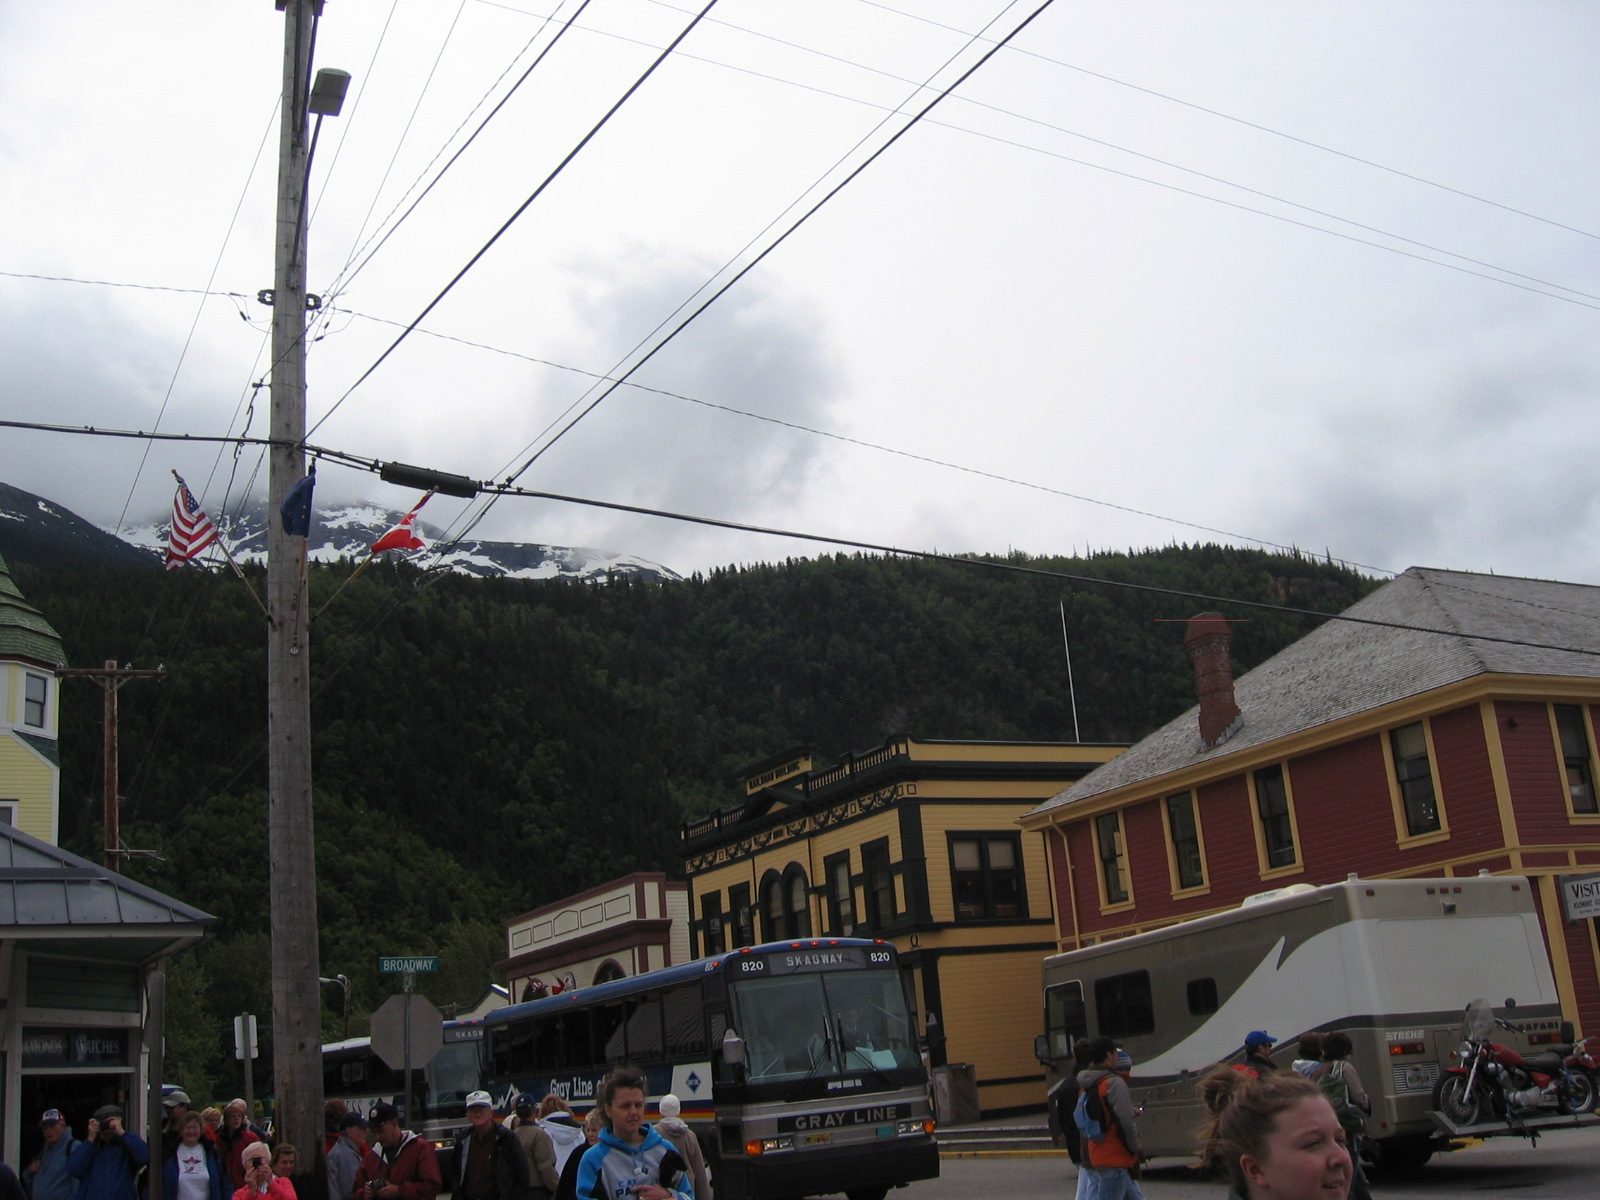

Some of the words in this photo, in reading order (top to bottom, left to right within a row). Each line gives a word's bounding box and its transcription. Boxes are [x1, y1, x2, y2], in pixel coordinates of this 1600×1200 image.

[786, 953, 844, 967] SKAGWAY
[870, 952, 890, 962] 820
[383, 959, 433, 971] BROADWAY
[741, 961, 764, 972] 820
[1518, 1021, 1559, 1031] SAFARI
[75, 1040, 120, 1054] WATCHES
[550, 1078, 570, 1100] Gray
[572, 1077, 593, 1096] Line
[795, 1112, 842, 1130] GRAY
[853, 1106, 897, 1124] LINE
